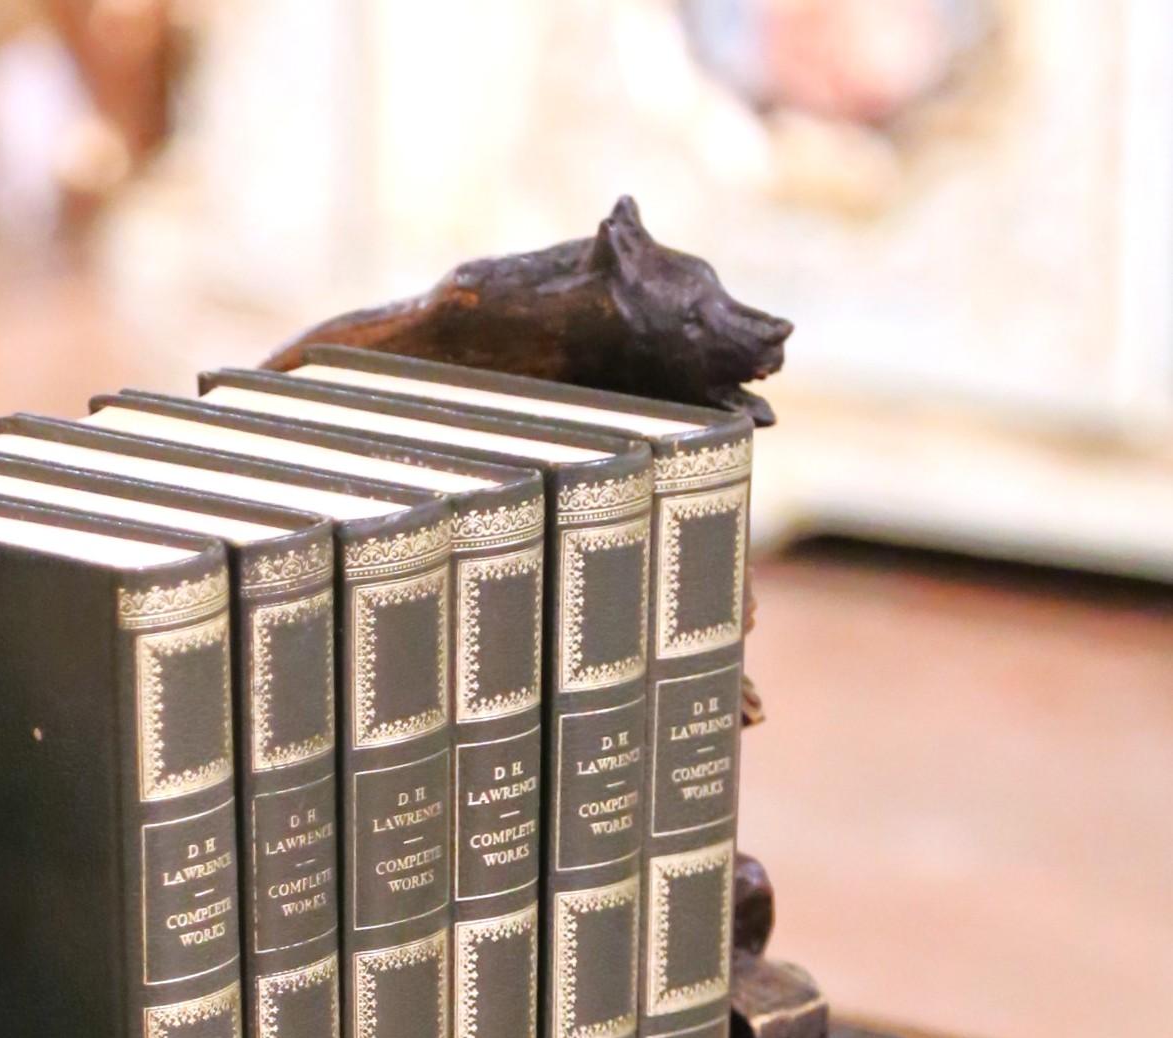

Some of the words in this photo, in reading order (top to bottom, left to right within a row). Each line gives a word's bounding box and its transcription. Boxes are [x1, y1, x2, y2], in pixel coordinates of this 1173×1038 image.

[693, 701, 703, 716] D
[708, 697, 719, 713] H
[601, 736, 613, 751] D
[618, 731, 629, 746] H
[494, 766, 506, 780] D
[511, 761, 524, 777] H
[397, 792, 409, 806] D
[415, 787, 426, 802] H
[290, 815, 300, 828] D
[307, 808, 316, 823] H
[188, 844, 199, 859] D
[205, 837, 216, 854] H
[483, 843, 530, 867] WORKS
[387, 868, 434, 893] WORKS
[167, 897, 232, 930] COMPLETE
[281, 892, 327, 917] WORKS
[179, 922, 226, 947] WORKS
